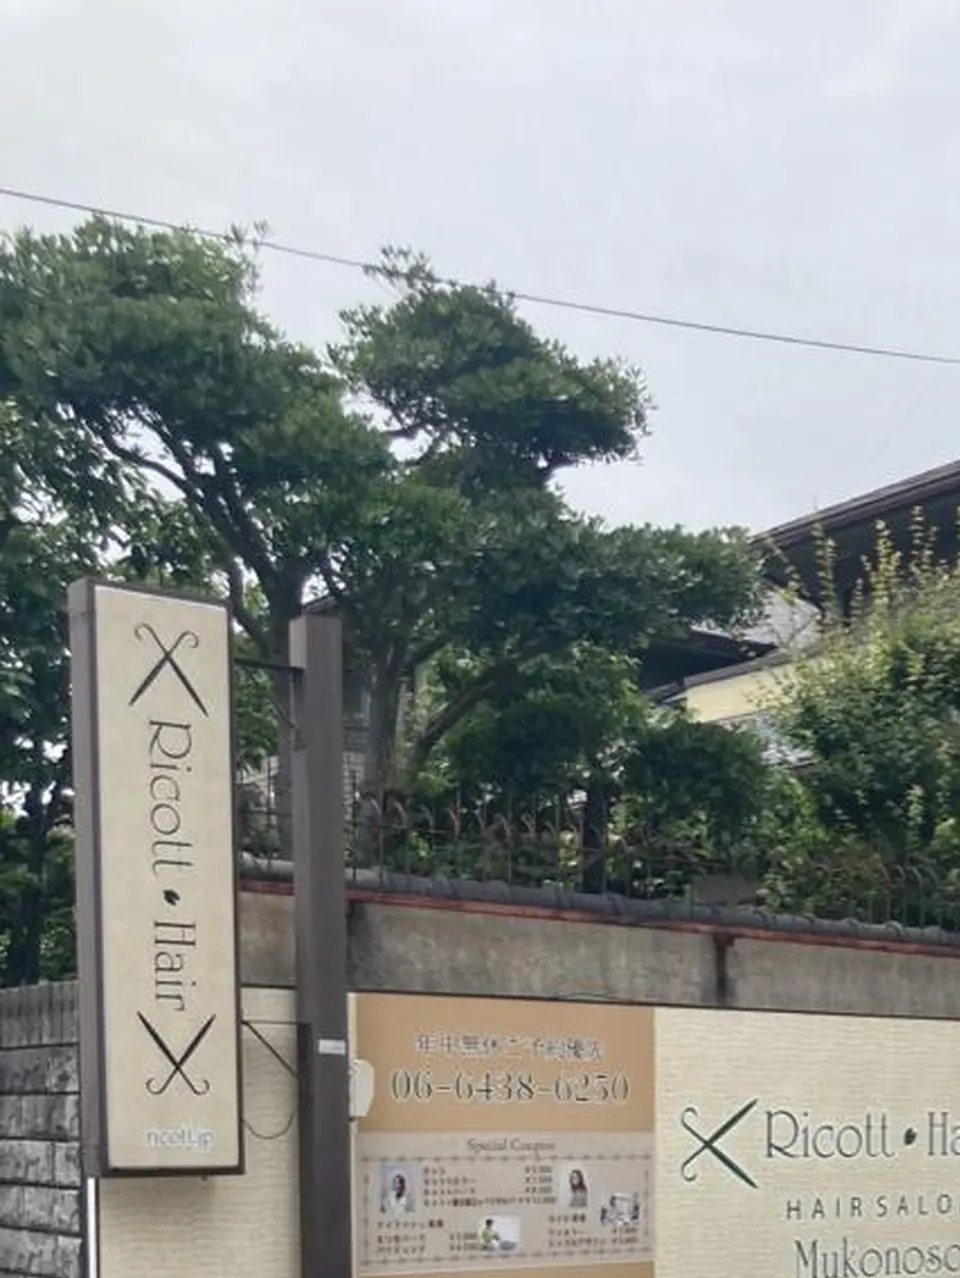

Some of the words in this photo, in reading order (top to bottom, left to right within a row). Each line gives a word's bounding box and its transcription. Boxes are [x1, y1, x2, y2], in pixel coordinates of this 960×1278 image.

[149, 719, 194, 878] Ricott
[153, 920, 197, 1012] Hair
[391, 1070, 629, 1102] 06-6438-6250
[765, 1108, 896, 1159] Ricott
